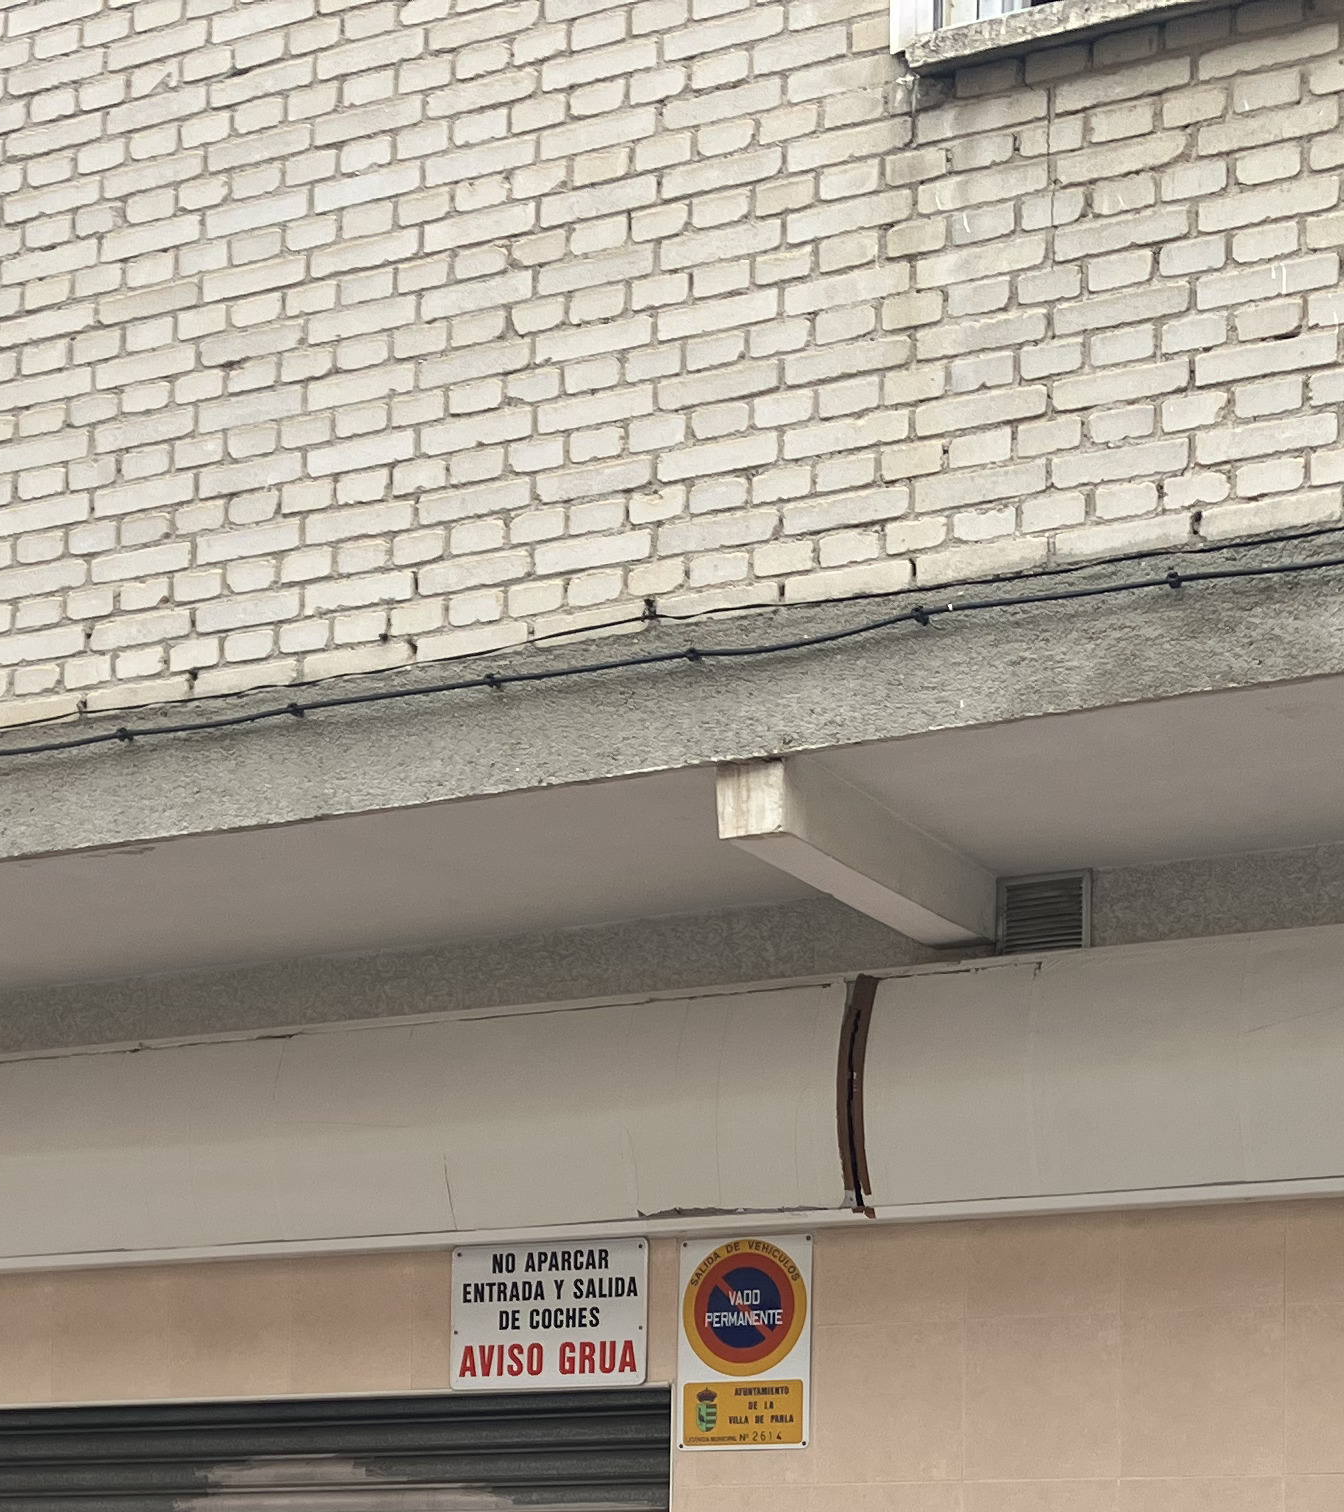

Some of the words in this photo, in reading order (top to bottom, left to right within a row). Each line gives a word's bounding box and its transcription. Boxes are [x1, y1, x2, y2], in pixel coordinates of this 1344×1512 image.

[492, 1253, 515, 1274] NO
[524, 1249, 609, 1272] APARCAR
[690, 1252, 721, 1286] SALIDA
[726, 1242, 740, 1254] DE
[748, 1241, 801, 1282] VEHICULOS
[463, 1281, 545, 1303] ENTRADA
[554, 1279, 564, 1300] Y
[573, 1276, 638, 1299] SALIDA
[728, 1289, 760, 1305] VADO
[498, 1310, 520, 1330] DE
[529, 1306, 600, 1330] COCHES
[704, 1309, 783, 1327] PERMANENTE
[459, 1342, 543, 1377] AVISO
[559, 1339, 637, 1375] GRUA
[734, 1386, 789, 1396] AYUNTAMIENTO
[748, 1401, 758, 1410] DE
[764, 1401, 774, 1409] LA
[728, 1415, 749, 1424] VILLA
[755, 1415, 764, 1424] DE
